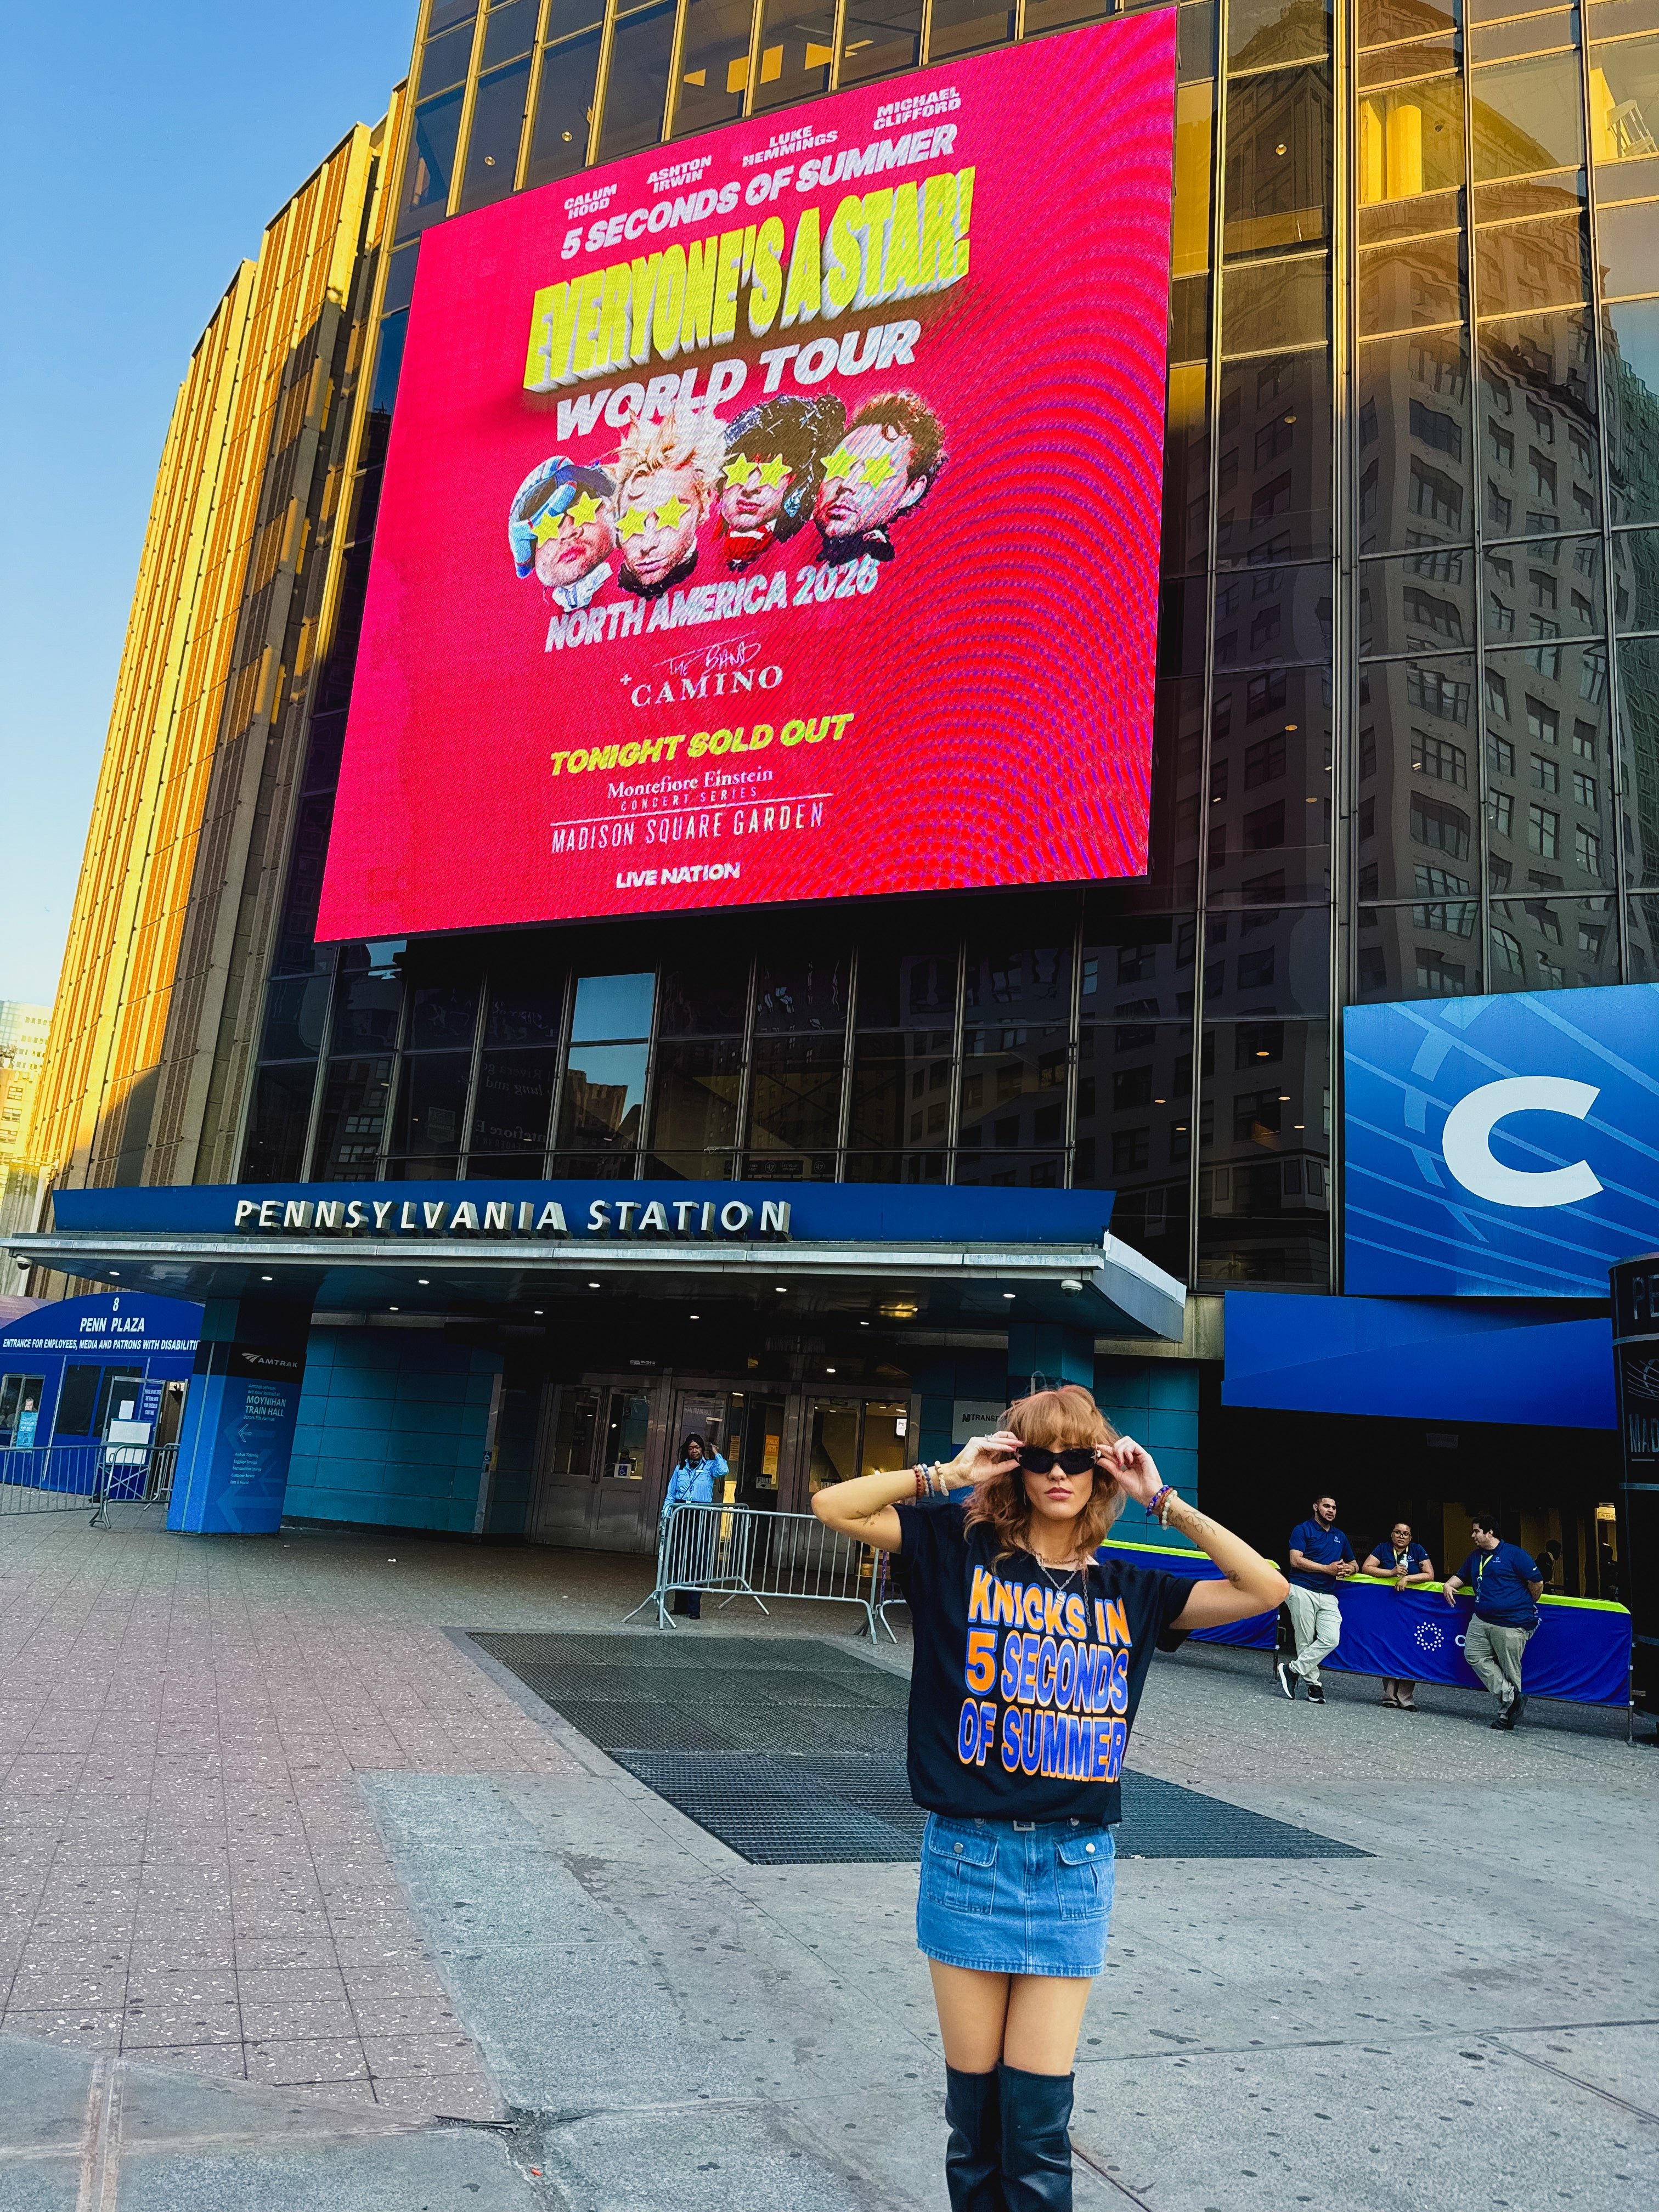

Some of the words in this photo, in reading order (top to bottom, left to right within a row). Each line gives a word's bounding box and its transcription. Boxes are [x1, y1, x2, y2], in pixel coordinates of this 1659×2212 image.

[873, 99, 961, 131] CLIFFORD
[877, 87, 960, 117] MICHAEL
[743, 131, 838, 167] HEMMINGS
[769, 125, 812, 148] LUKE
[647, 156, 712, 183] ASHTON
[653, 170, 703, 194] IRWIN
[560, 227, 582, 259] 5
[585, 184, 740, 252] SECONDS
[745, 167, 792, 206] OF
[796, 123, 958, 191] SUMMER
[564, 184, 617, 211] CALUM
[567, 196, 610, 219] HOOD
[523, 216, 785, 393] EVERYONE'S
[781, 207, 821, 329] A
[820, 166, 977, 318] STAR!
[556, 358, 747, 441] WORLD
[759, 319, 921, 394] TOUR
[544, 599, 647, 653] NORTH
[645, 571, 788, 634] AMERICA
[792, 554, 880, 606] 2026
[630, 665, 783, 708] CAMINO
[550, 734, 685, 776] TONIGHT
[687, 724, 773, 759] SOLD
[780, 713, 855, 746] OUT
[607, 775, 698, 800] Montefiore
[702, 767, 774, 788] Einstein
[620, 794, 689, 812] CONCERT
[700, 786, 758, 803] SERIES
[551, 822, 635, 854] MADISON
[645, 812, 722, 844] SQUARE
[733, 802, 824, 836] GARDEN
[616, 868, 657, 889] LIVE
[661, 862, 741, 885] NATION
[1442, 1075, 1604, 1207] C
[234, 1199, 569, 1233] PENNSYLVANIA
[587, 1199, 790, 1234] STATION
[112, 1297, 120, 1312] 8
[80, 1318, 107, 1332] PENN
[111, 1317, 145, 1332] PLAZA
[3, 1339, 31, 1348] ENTRANCE
[32, 1339, 43, 1348] FOR
[43, 1339, 77, 1350] EMPLOYEES,
[79, 1340, 97, 1350] MEDIA
[98, 1340, 111, 1349] AND
[113, 1340, 141, 1350] PATRONS
[143, 1340, 159, 1350] WITH
[258, 1358, 298, 1368] AMTRAK
[245, 1406, 266, 1415] TRAIN
[268, 1408, 284, 1417] HALL
[246, 1396, 286, 1407] MOYNIHAN
[971, 1414, 1000, 1422] TRANSI
[968, 1565, 1087, 1640] KNICKS
[1094, 1594, 1132, 1647] IN
[964, 1628, 998, 1696] 5
[1001, 1630, 1130, 1715] SECONDS
[958, 1697, 997, 1766] OF
[1001, 1705, 1127, 1783] SUMMER
